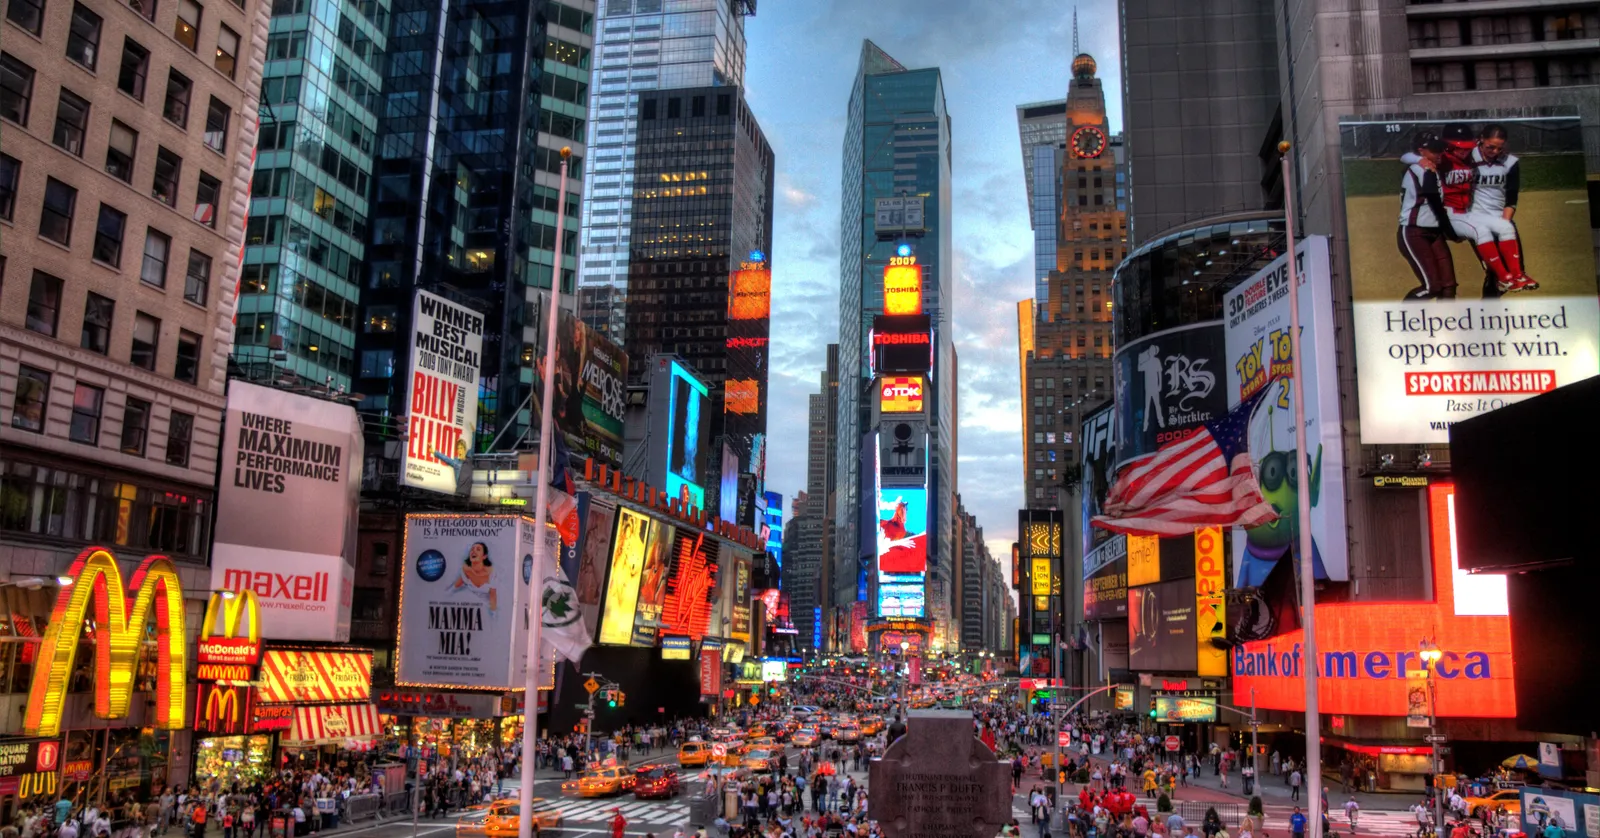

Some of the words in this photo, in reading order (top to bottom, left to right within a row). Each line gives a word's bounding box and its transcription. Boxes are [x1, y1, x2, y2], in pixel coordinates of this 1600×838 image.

[1266, 250, 1304, 294] EVET
[886, 286, 920, 294] TOSHIBA
[1244, 277, 1266, 298] DOUBLE
[420, 294, 482, 336] WINNER
[1229, 293, 1244, 317] 3D
[433, 320, 468, 346] BEST
[1384, 308, 1474, 338] Helped
[1480, 305, 1570, 337] injured
[416, 331, 480, 368] MUSICAL
[874, 333, 930, 345] TOSHIBA
[1388, 339, 1507, 366] opponent
[1511, 334, 1569, 357] win.
[419, 350, 436, 371] 2009
[437, 356, 453, 377] TONY
[453, 362, 475, 384] AWARD
[1235, 336, 1264, 388] TOY
[1271, 363, 1293, 376] STOR
[582, 360, 623, 401] MELROSE
[892, 387, 920, 397] TDK
[1242, 370, 1265, 399] STORY
[1276, 376, 1291, 411] 2
[1409, 372, 1552, 393] SPORTSMANSHIP
[412, 371, 458, 423] BILLY
[602, 392, 625, 423] PLACE
[1446, 399, 1473, 412] Pass
[1477, 399, 1488, 412] It
[242, 411, 292, 435] WHERE
[238, 427, 342, 467] MAXIMUM
[408, 415, 462, 467] ELLIOT
[236, 451, 340, 482] PERFORMANCE
[234, 467, 286, 494] LIVES
[424, 528, 431, 536] IS
[432, 528, 439, 536] A
[434, 518, 478, 528] FEEL-GOOD
[480, 518, 515, 528] MUSICAL
[224, 568, 329, 602] maxell
[258, 601, 326, 612] ww.maxell.com
[428, 606, 484, 631] MAMMA
[200, 644, 256, 656] McDonald's
[438, 631, 472, 656] MIA!
[1235, 644, 1278, 677] Bank
[1281, 642, 1301, 677] of
[1315, 650, 1491, 679] merca
[896, 782, 937, 792] FRANCIS
[950, 783, 985, 793] DUFFY
